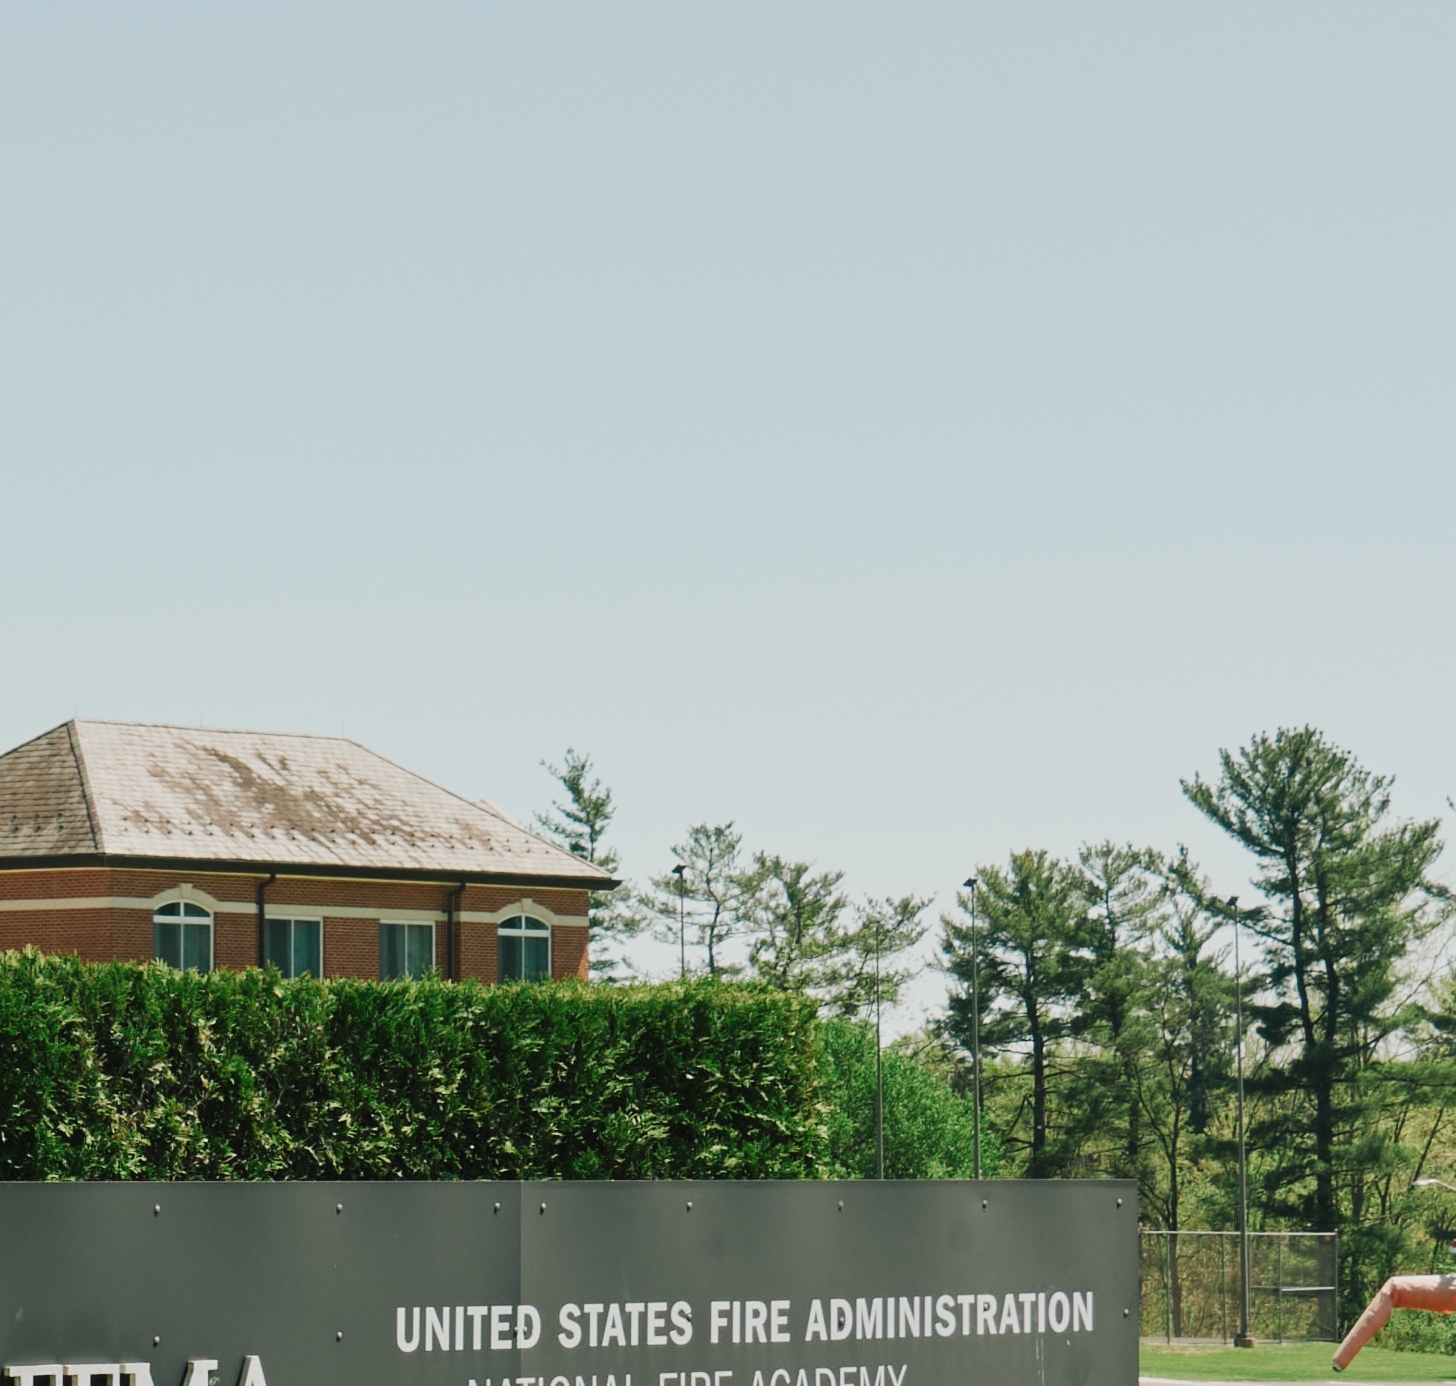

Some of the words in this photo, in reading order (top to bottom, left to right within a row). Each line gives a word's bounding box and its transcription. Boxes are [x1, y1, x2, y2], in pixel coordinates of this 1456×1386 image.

[396, 1304, 542, 1353] UNITED
[557, 1300, 693, 1349] STATES
[710, 1299, 791, 1344] FIRE
[804, 1291, 1094, 1342] ADMINISTRATION
